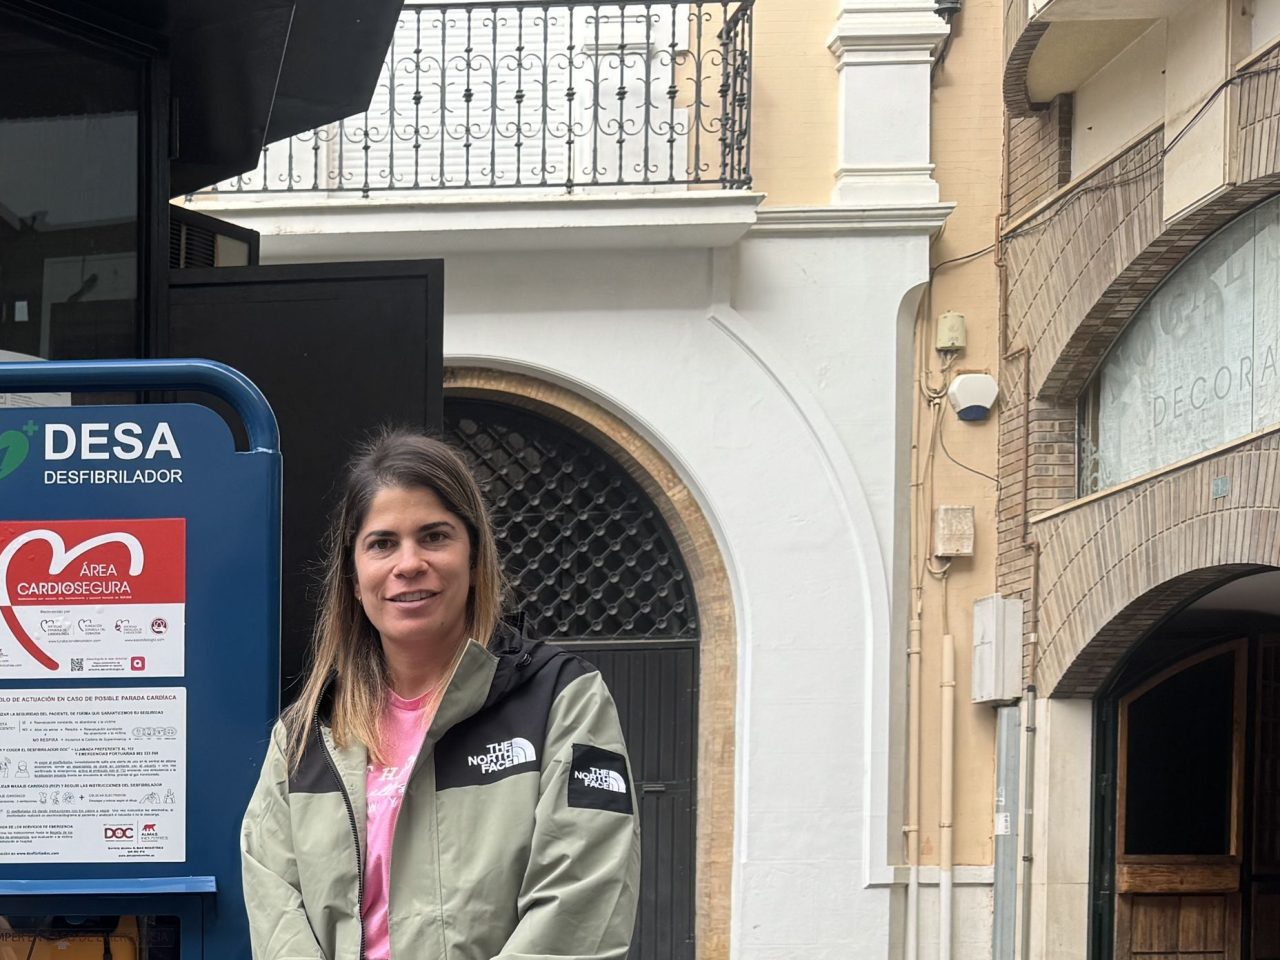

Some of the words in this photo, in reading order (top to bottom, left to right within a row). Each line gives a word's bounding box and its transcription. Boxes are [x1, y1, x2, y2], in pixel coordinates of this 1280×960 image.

[44, 422, 181, 461] DESA
[44, 469, 183, 485] DESFIBRILADOR
[79, 562, 117, 577] ÁREA
[17, 581, 131, 595] CARDIOSEGURA
[486, 741, 512, 755] THE
[467, 749, 513, 766] NORTH
[481, 758, 514, 774] FACE
[589, 767, 610, 777] THE
[574, 770, 611, 784] NORTH
[584, 779, 611, 790] FACE
[104, 827, 134, 839] DOC
